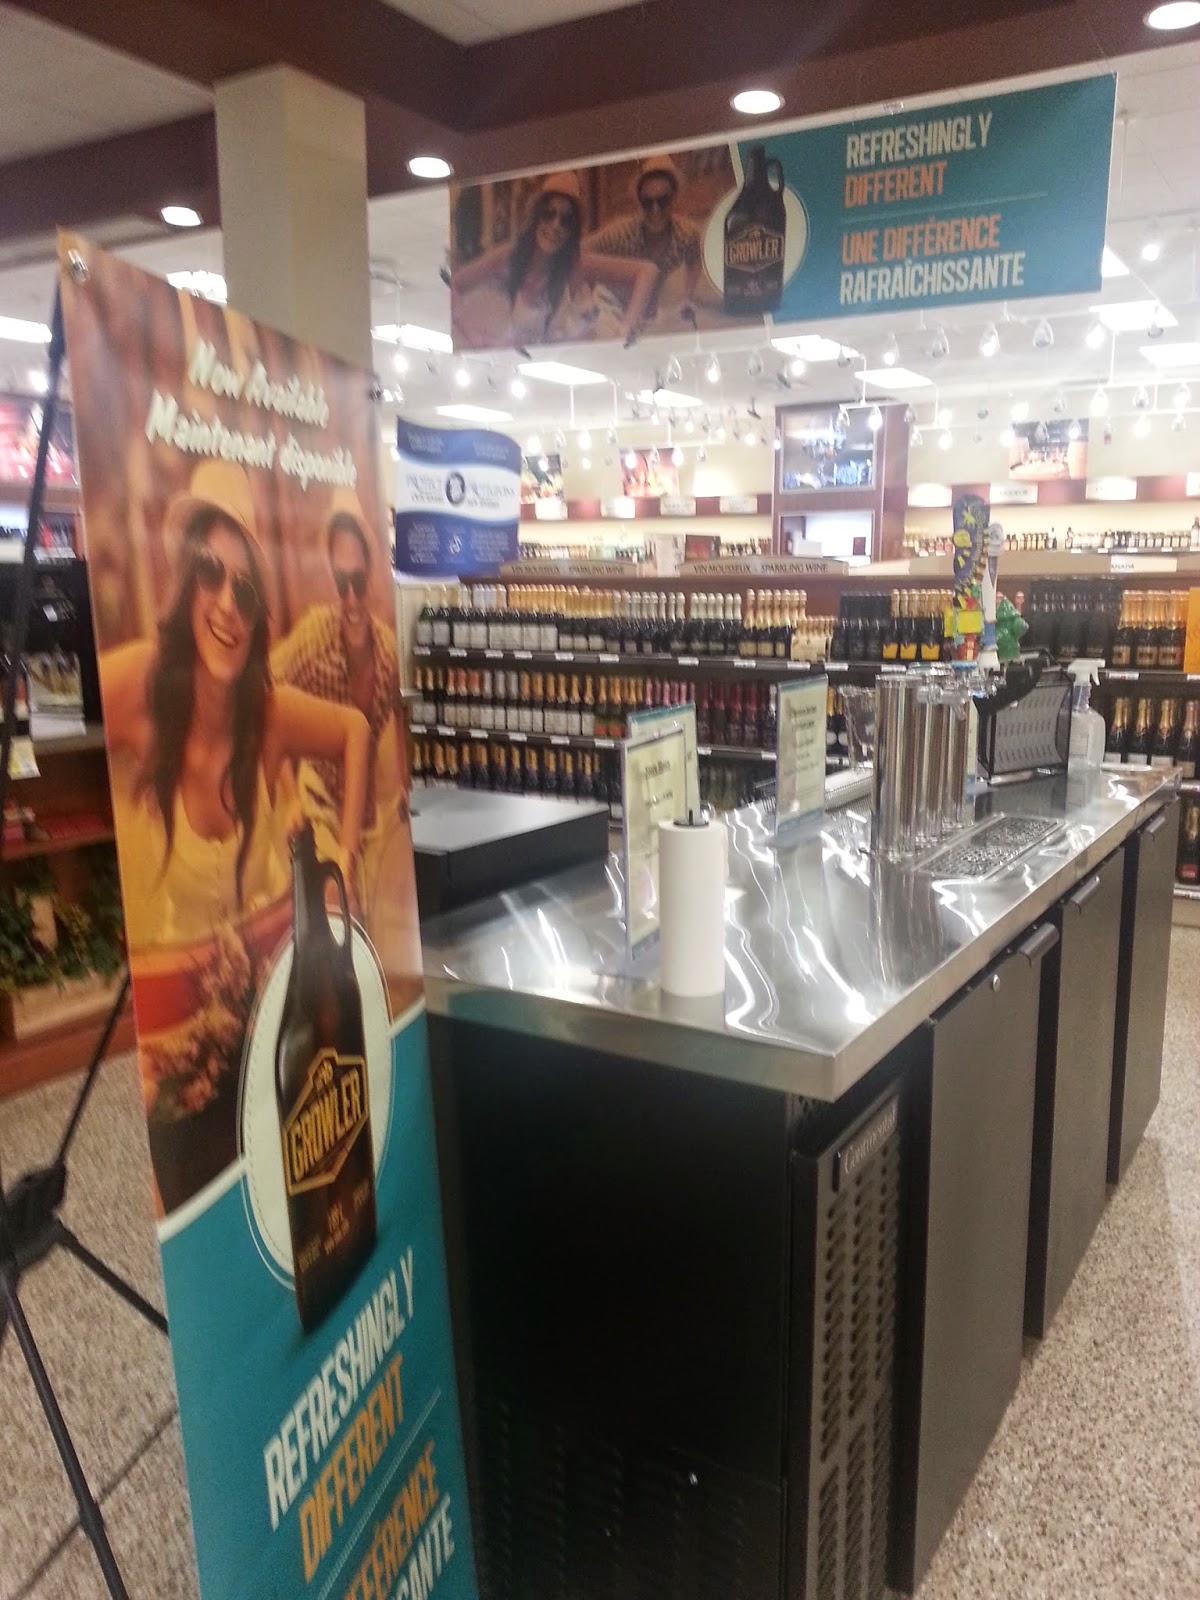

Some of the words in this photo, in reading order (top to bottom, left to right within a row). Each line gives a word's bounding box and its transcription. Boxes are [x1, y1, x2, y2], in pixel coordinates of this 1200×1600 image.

[845, 110, 993, 169] REFRESHINGLY
[844, 159, 948, 209] DIFFERENT
[842, 229, 879, 266] UNE
[882, 212, 1002, 262] DIFFÉRENCE
[840, 250, 1026, 306] RAFRAÎCHISSANTE
[188, 334, 245, 400] Now
[144, 387, 277, 471] Maintenant
[693, 565, 708, 575] VIN
[709, 565, 750, 575] MOUSSEUX
[761, 564, 803, 574] SPARKLING
[805, 563, 828, 573] WINE
[290, 1066, 362, 1183] GROWLER
[264, 1246, 414, 1532] REFRESHINGLY
[299, 1353, 404, 1585] DIFFERENT
